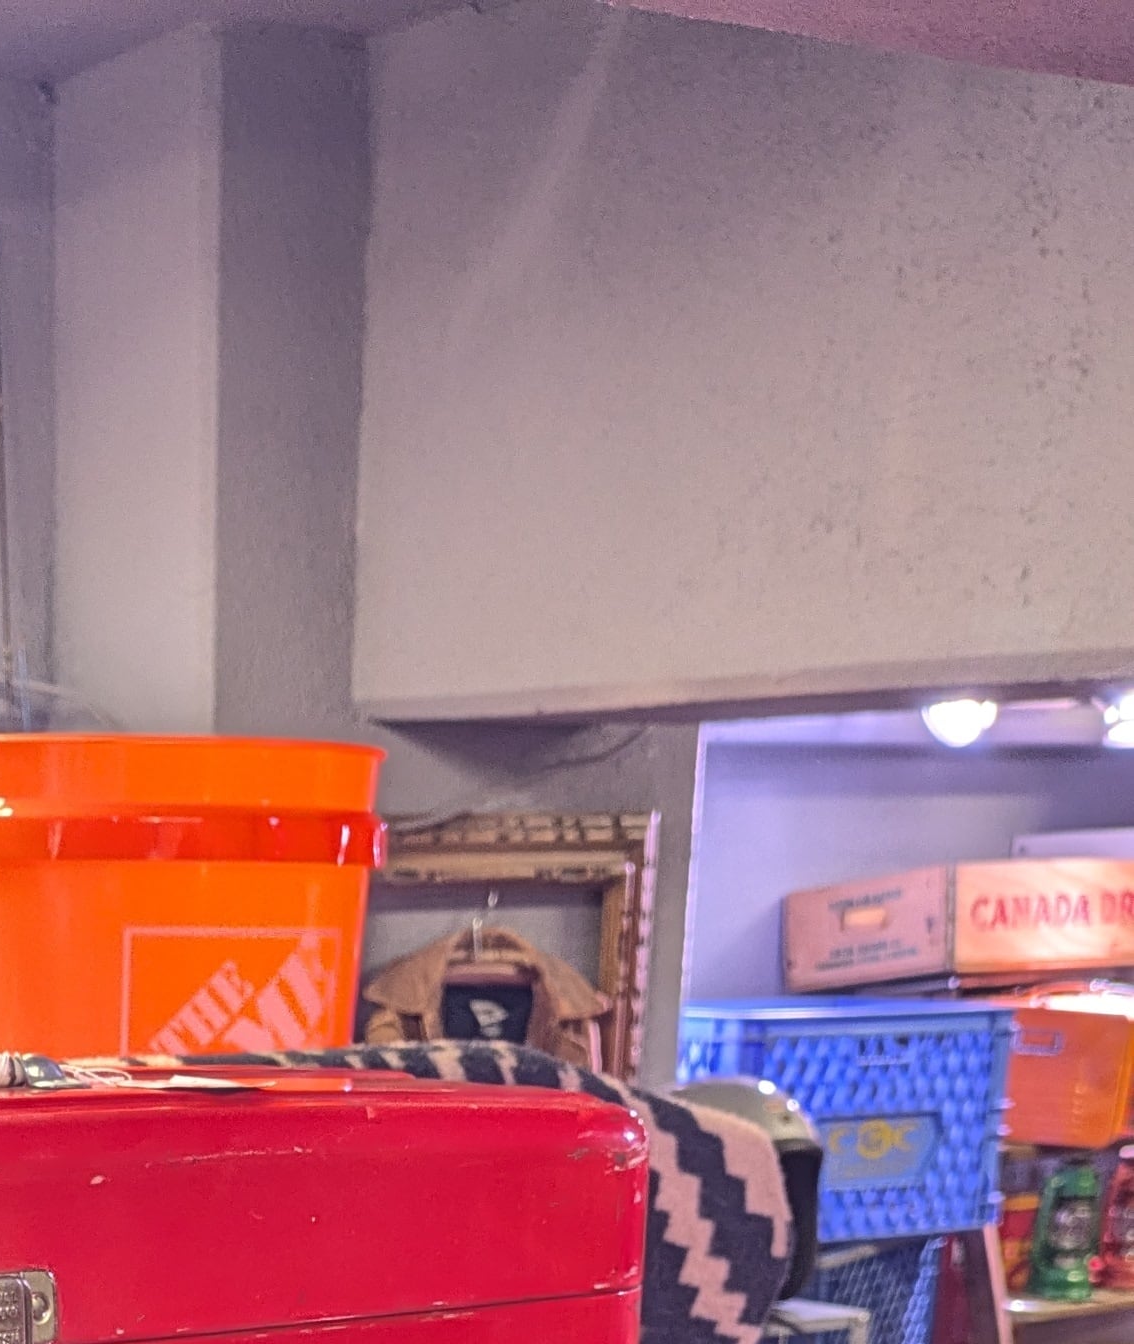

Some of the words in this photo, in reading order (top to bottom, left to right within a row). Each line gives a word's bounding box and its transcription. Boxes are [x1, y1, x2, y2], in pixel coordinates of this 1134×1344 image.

[969, 893, 1091, 932] CANADA
[1099, 889, 1134, 928] DR
[147, 958, 255, 1056] THE
[221, 932, 336, 1054] ME
